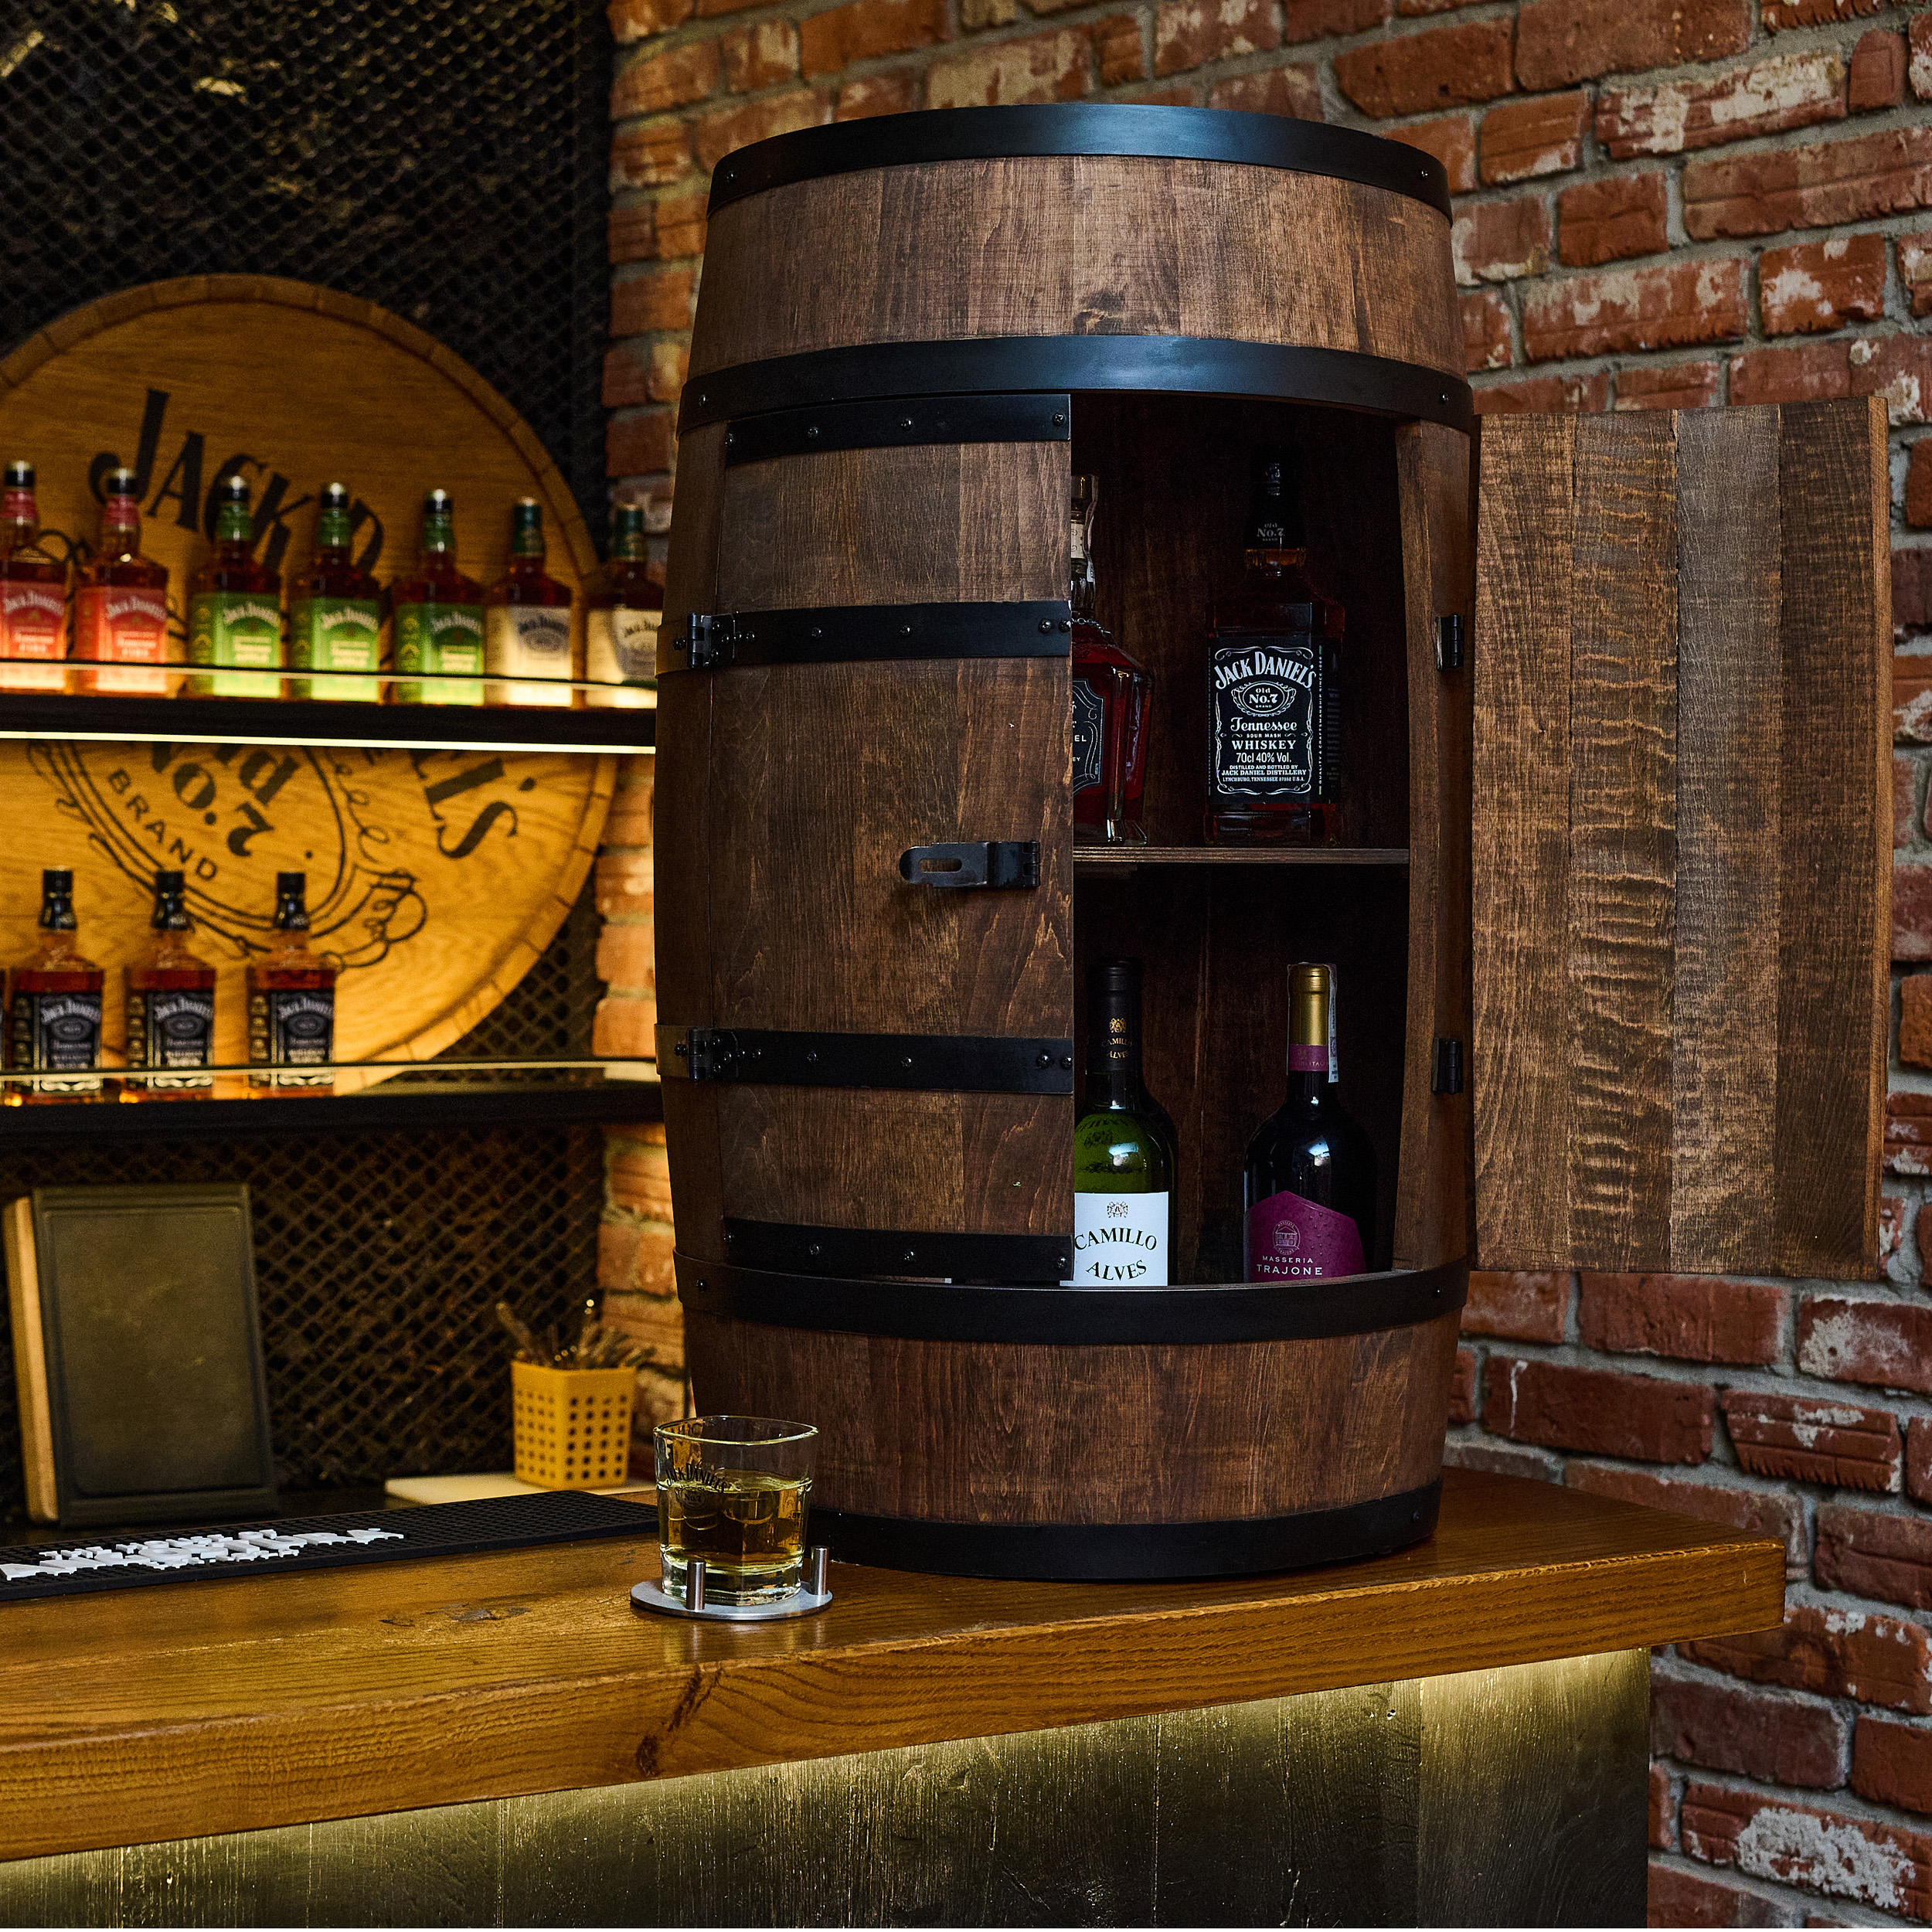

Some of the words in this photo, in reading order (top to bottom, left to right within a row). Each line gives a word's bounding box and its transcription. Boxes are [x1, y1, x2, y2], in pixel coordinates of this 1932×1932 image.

[1213, 658, 1253, 689] JACK
[1254, 651, 1317, 689] DANIEL'S
[1249, 694, 1278, 704] No.7
[1230, 717, 1298, 731] Tennessee
[1232, 740, 1297, 750] WHISKEY
[1236, 752, 1254, 763] 70cl
[1256, 752, 1275, 763] 40%
[1277, 752, 1292, 763] Vol.
[107, 768, 218, 881] BRAND
[1075, 1227, 1158, 1250] CAMILLO
[1262, 1255, 1313, 1264] MASSERIA
[1086, 1259, 1147, 1281] ALVES
[1257, 1264, 1323, 1275] TRAJONE
